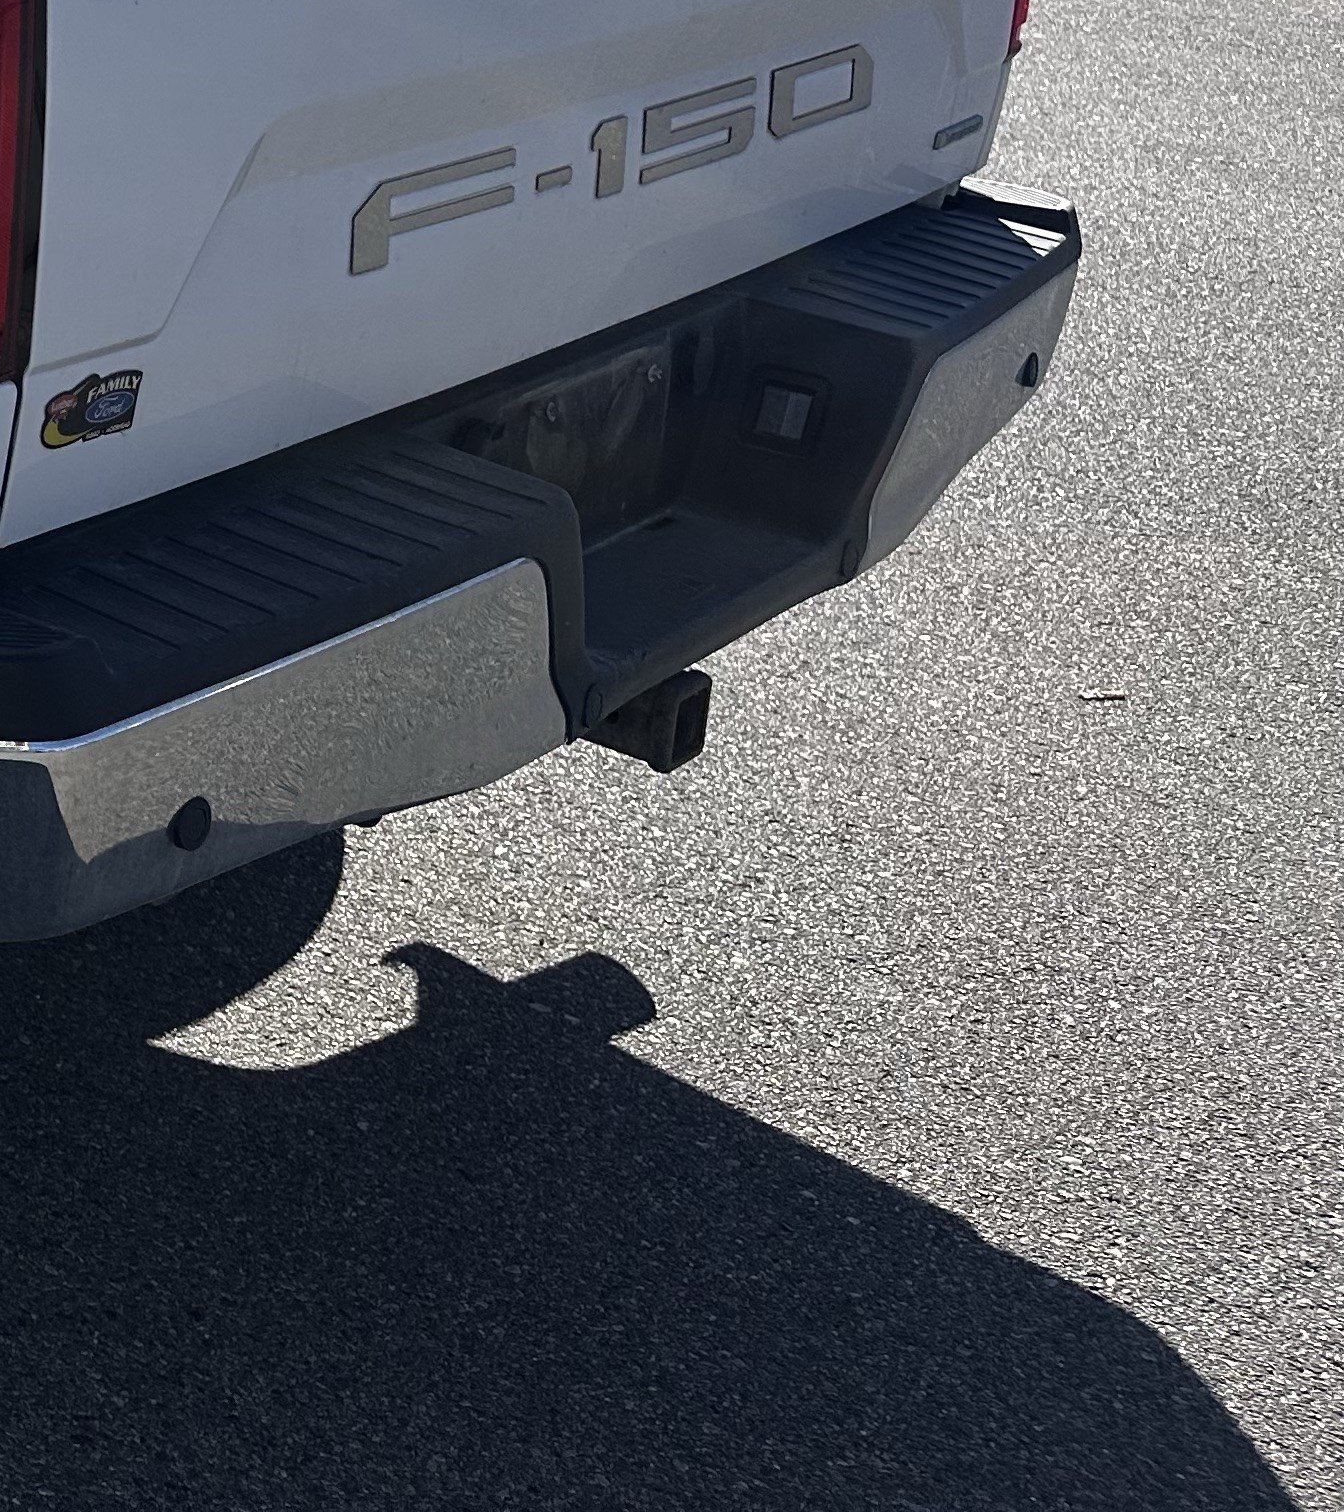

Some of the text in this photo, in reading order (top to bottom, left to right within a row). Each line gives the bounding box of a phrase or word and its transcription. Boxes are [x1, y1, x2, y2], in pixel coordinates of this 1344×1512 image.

[349, 44, 874, 275] F-150
[87, 375, 141, 403] FAMILY
[93, 395, 127, 419] Ford
